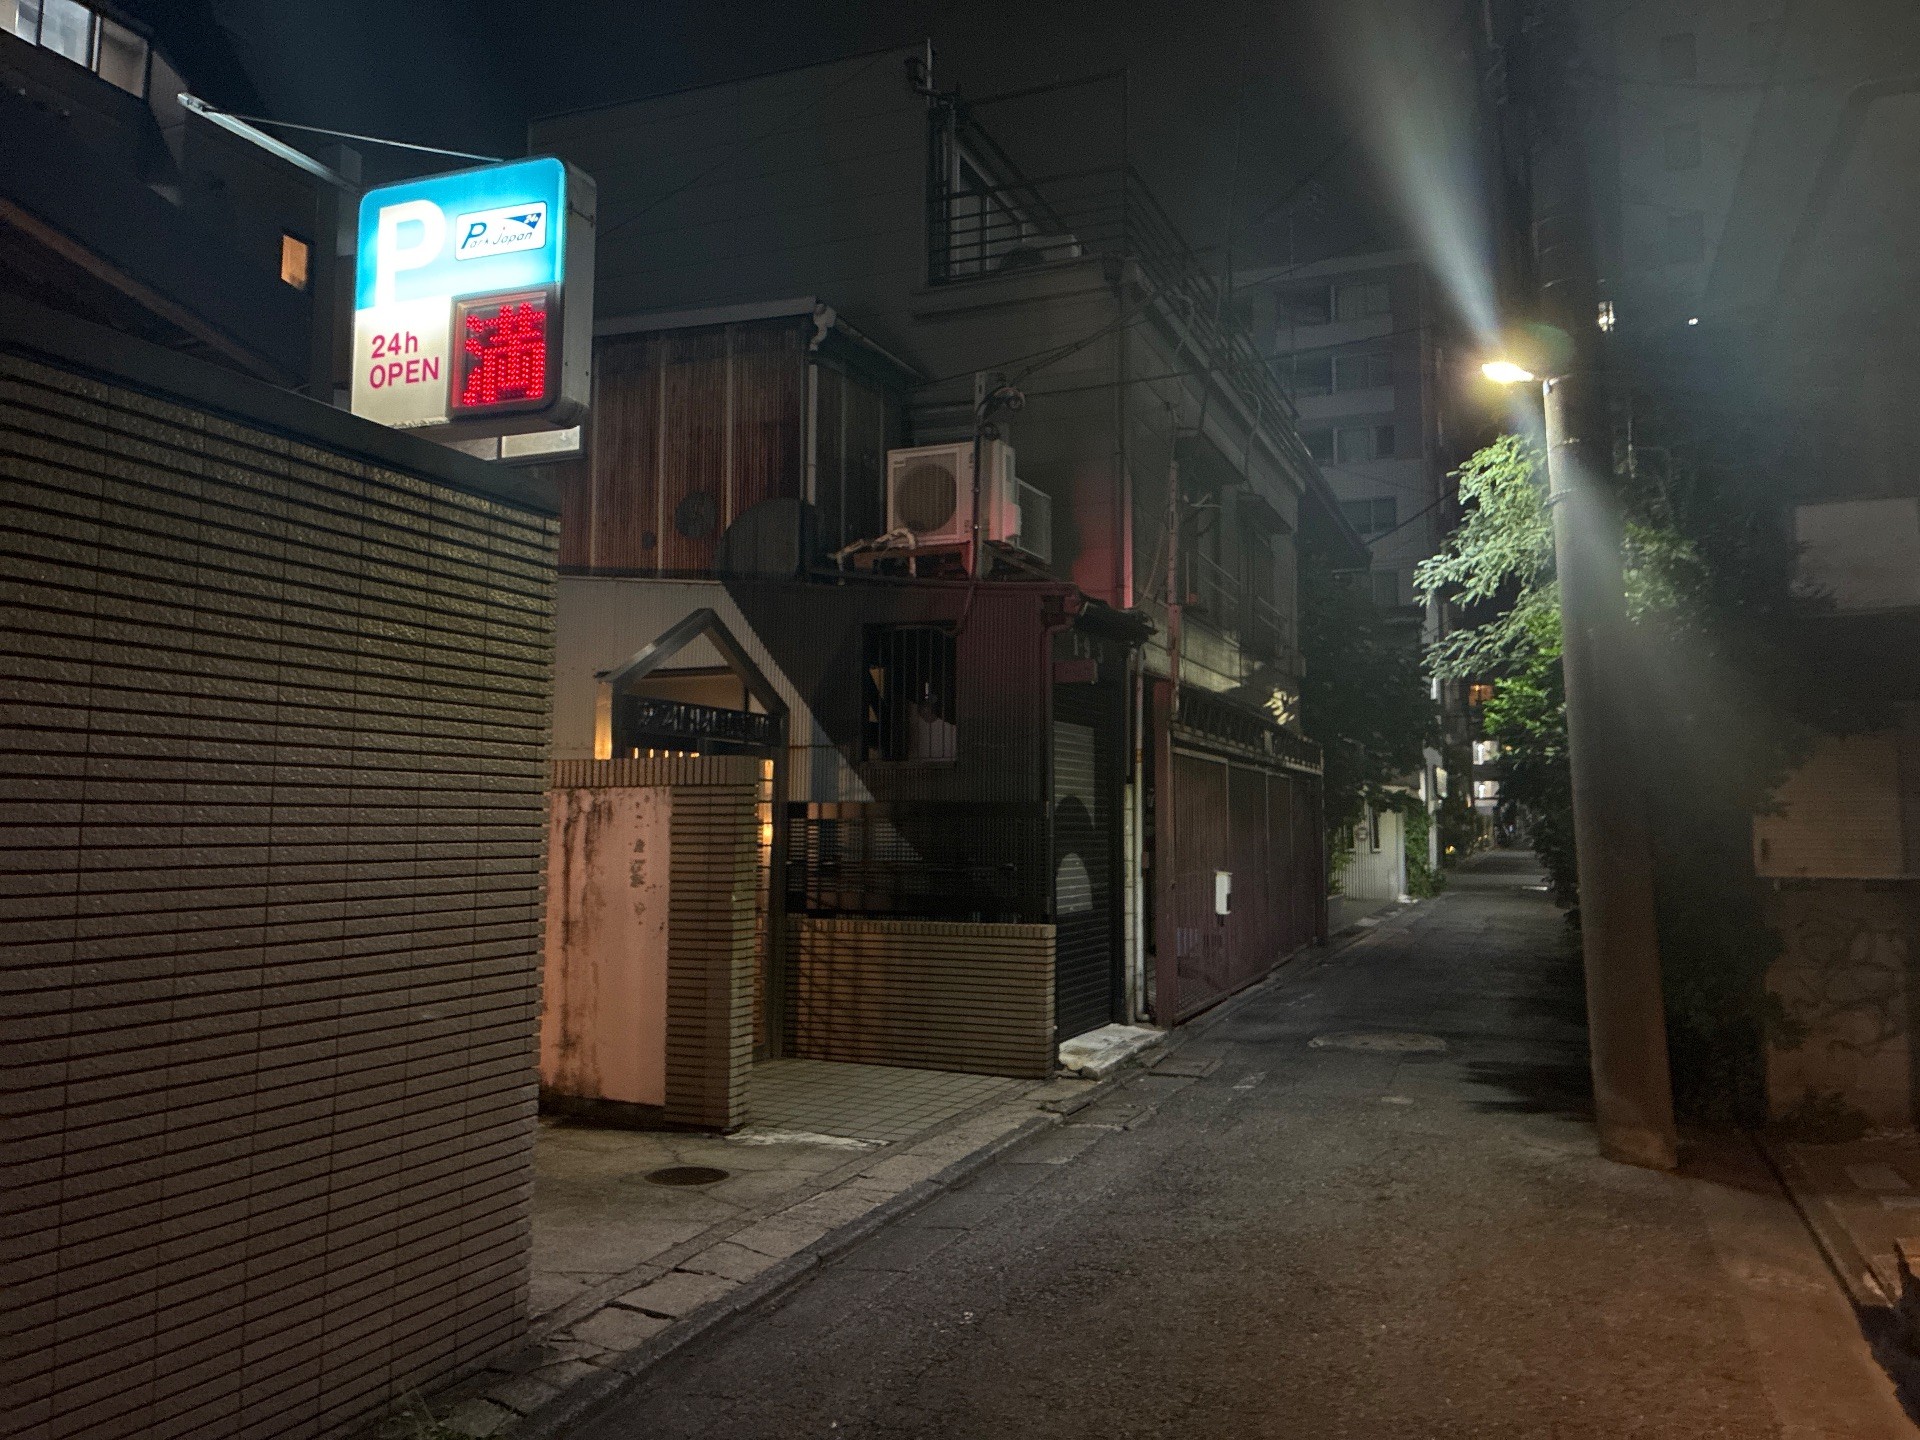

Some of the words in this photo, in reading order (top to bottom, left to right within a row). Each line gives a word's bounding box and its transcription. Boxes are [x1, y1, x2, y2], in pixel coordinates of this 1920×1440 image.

[461, 222, 489, 250] Park
[493, 227, 533, 246] Japan
[375, 199, 446, 311] P
[371, 331, 419, 358] 24h
[463, 302, 546, 406] 満
[370, 357, 440, 389] OPEN
